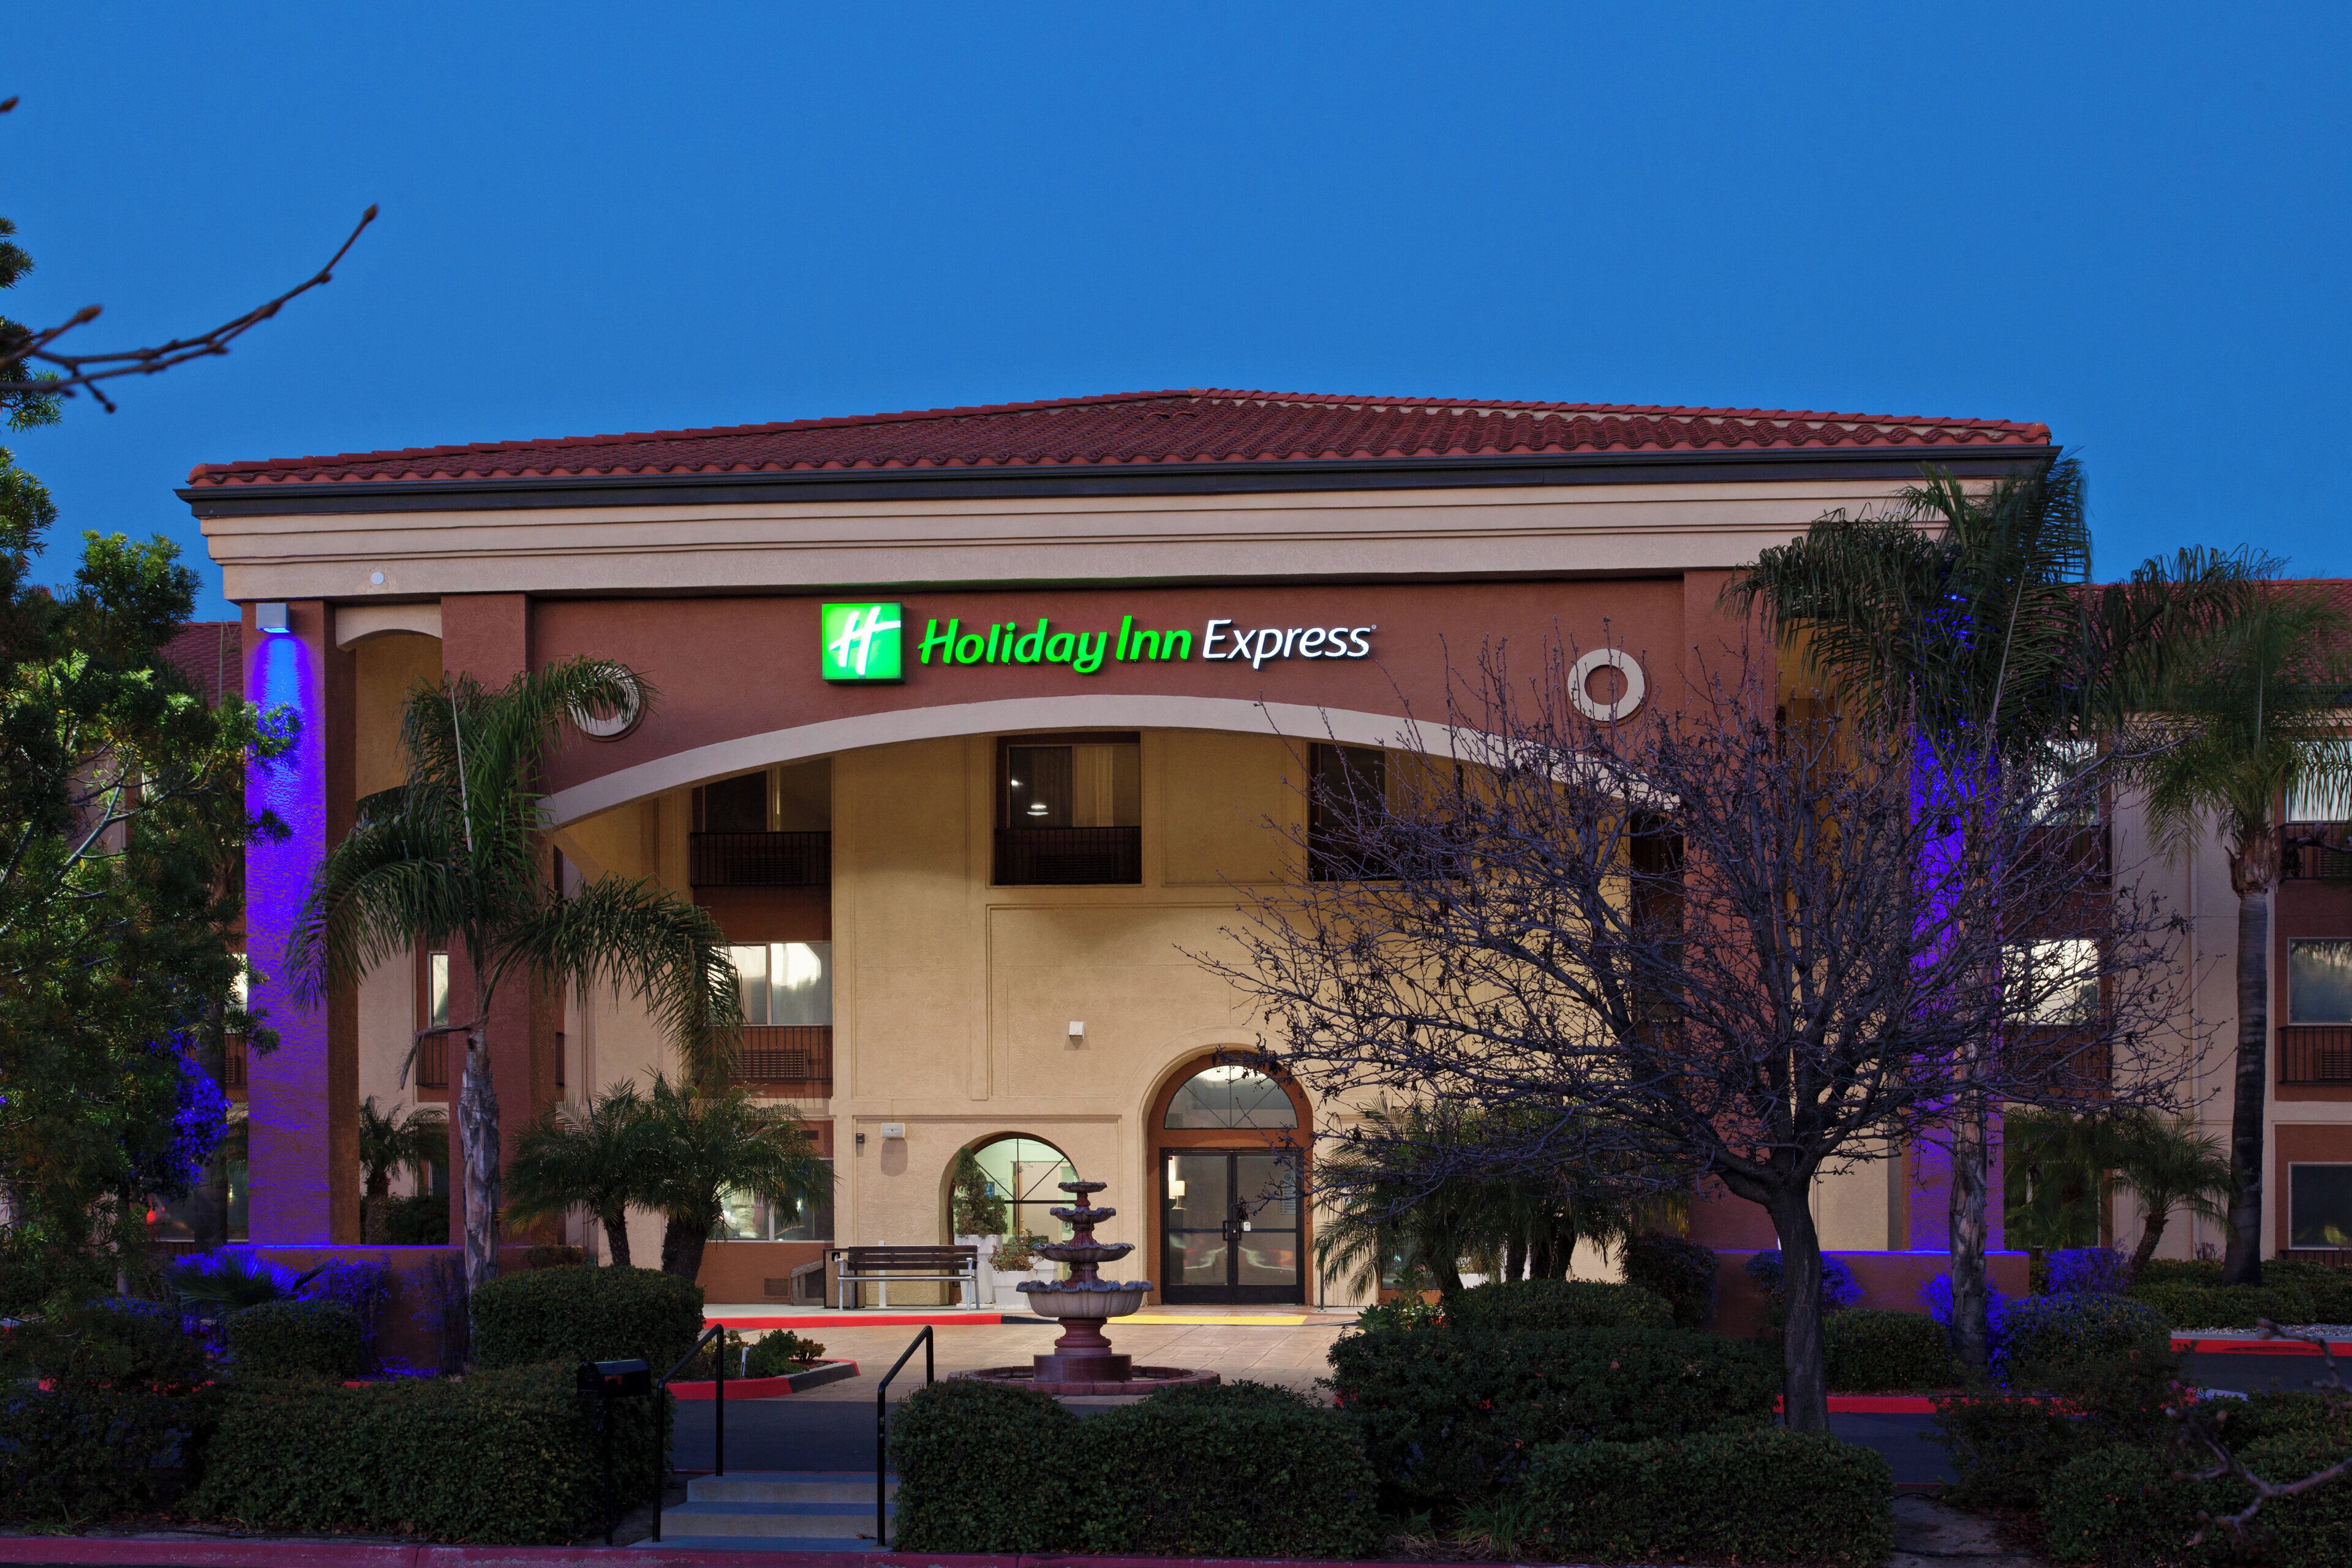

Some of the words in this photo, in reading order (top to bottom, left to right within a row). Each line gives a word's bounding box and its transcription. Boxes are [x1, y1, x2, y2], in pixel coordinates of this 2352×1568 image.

[917, 618, 1108, 673] Holiday
[1115, 615, 1192, 661] Inn
[1202, 619, 1371, 669] Express
